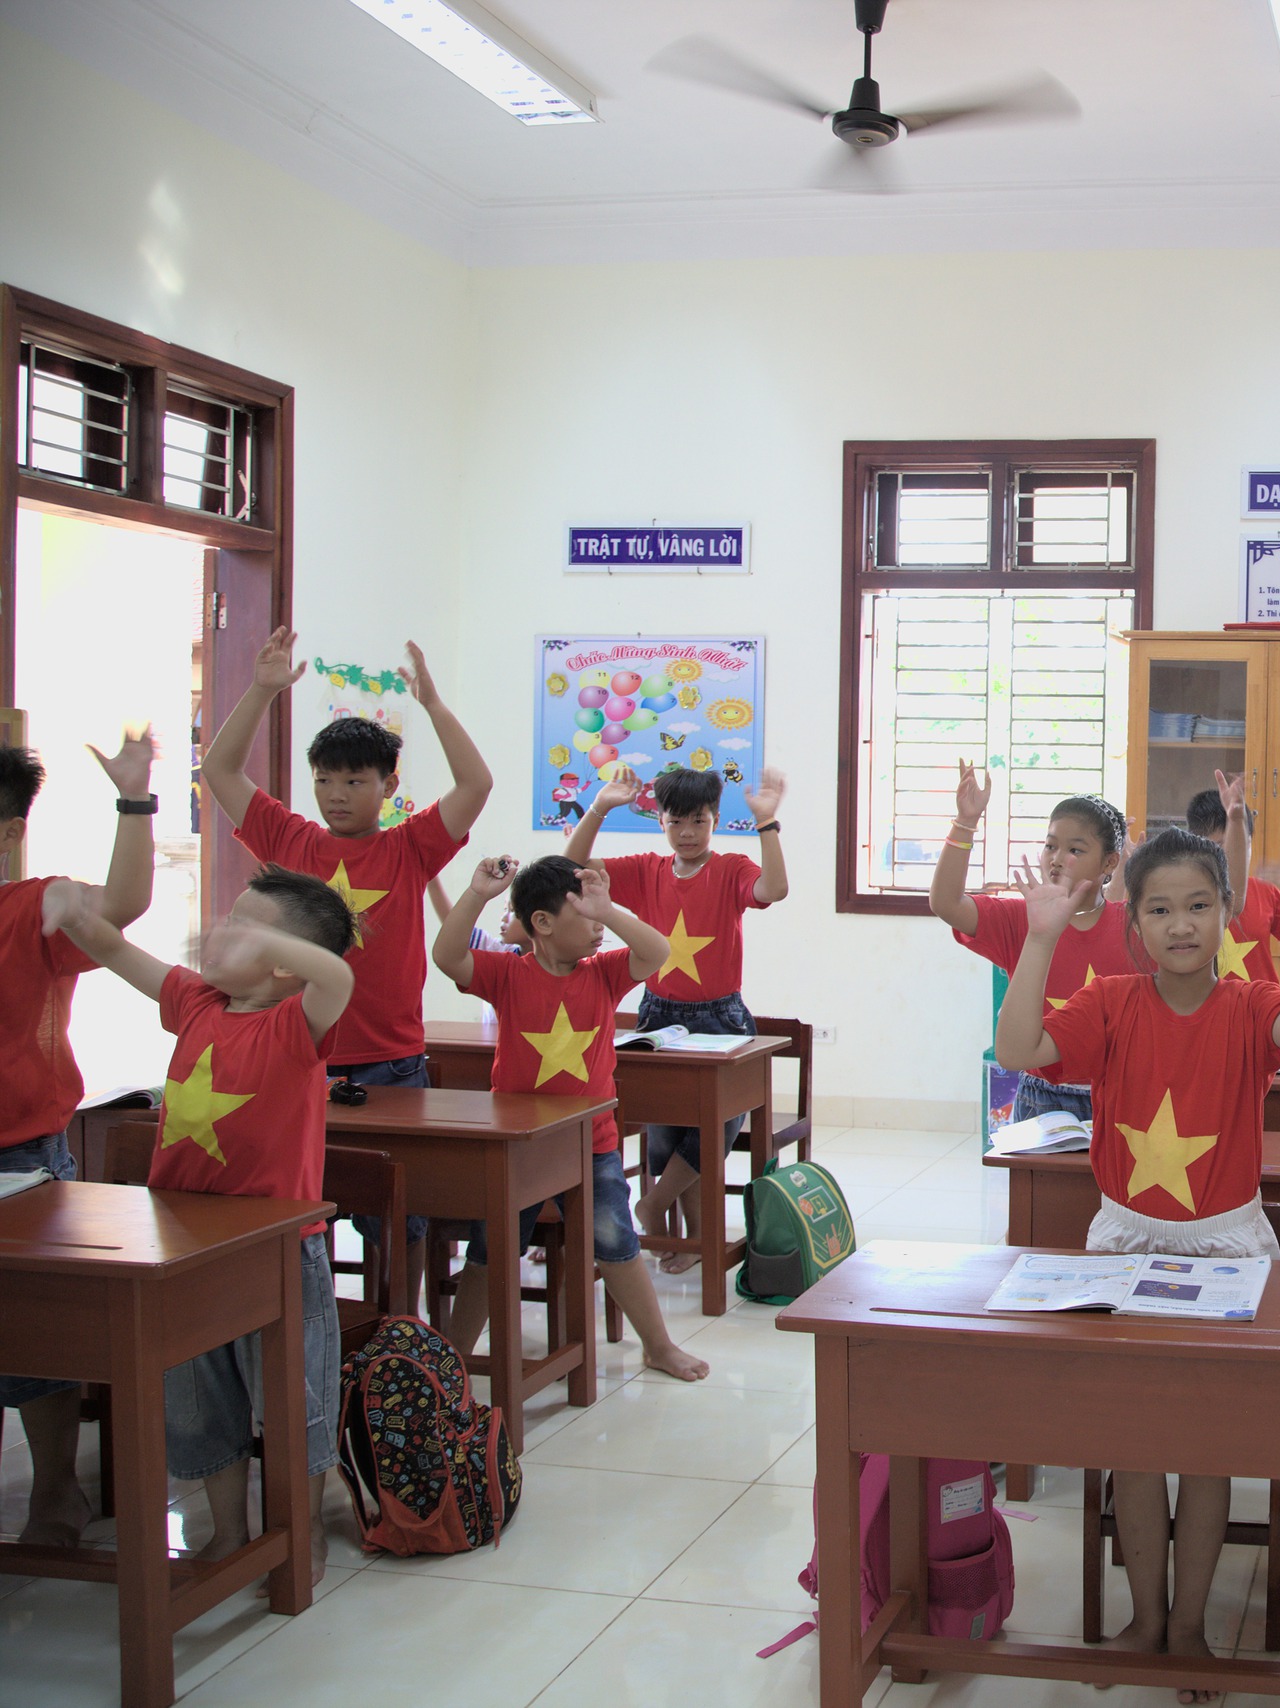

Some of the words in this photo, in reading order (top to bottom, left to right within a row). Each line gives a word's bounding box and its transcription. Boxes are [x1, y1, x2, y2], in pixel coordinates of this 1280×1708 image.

[577, 534, 621, 560] TRẬT
[626, 535, 653, 560] TỰ,
[659, 534, 705, 557] VÂNG
[709, 534, 737, 557] LỜI
[566, 651, 608, 671] Chúc
[607, 645, 654, 661] Mừng
[654, 644, 697, 659] Sinh
[698, 648, 748, 672] Nhật
